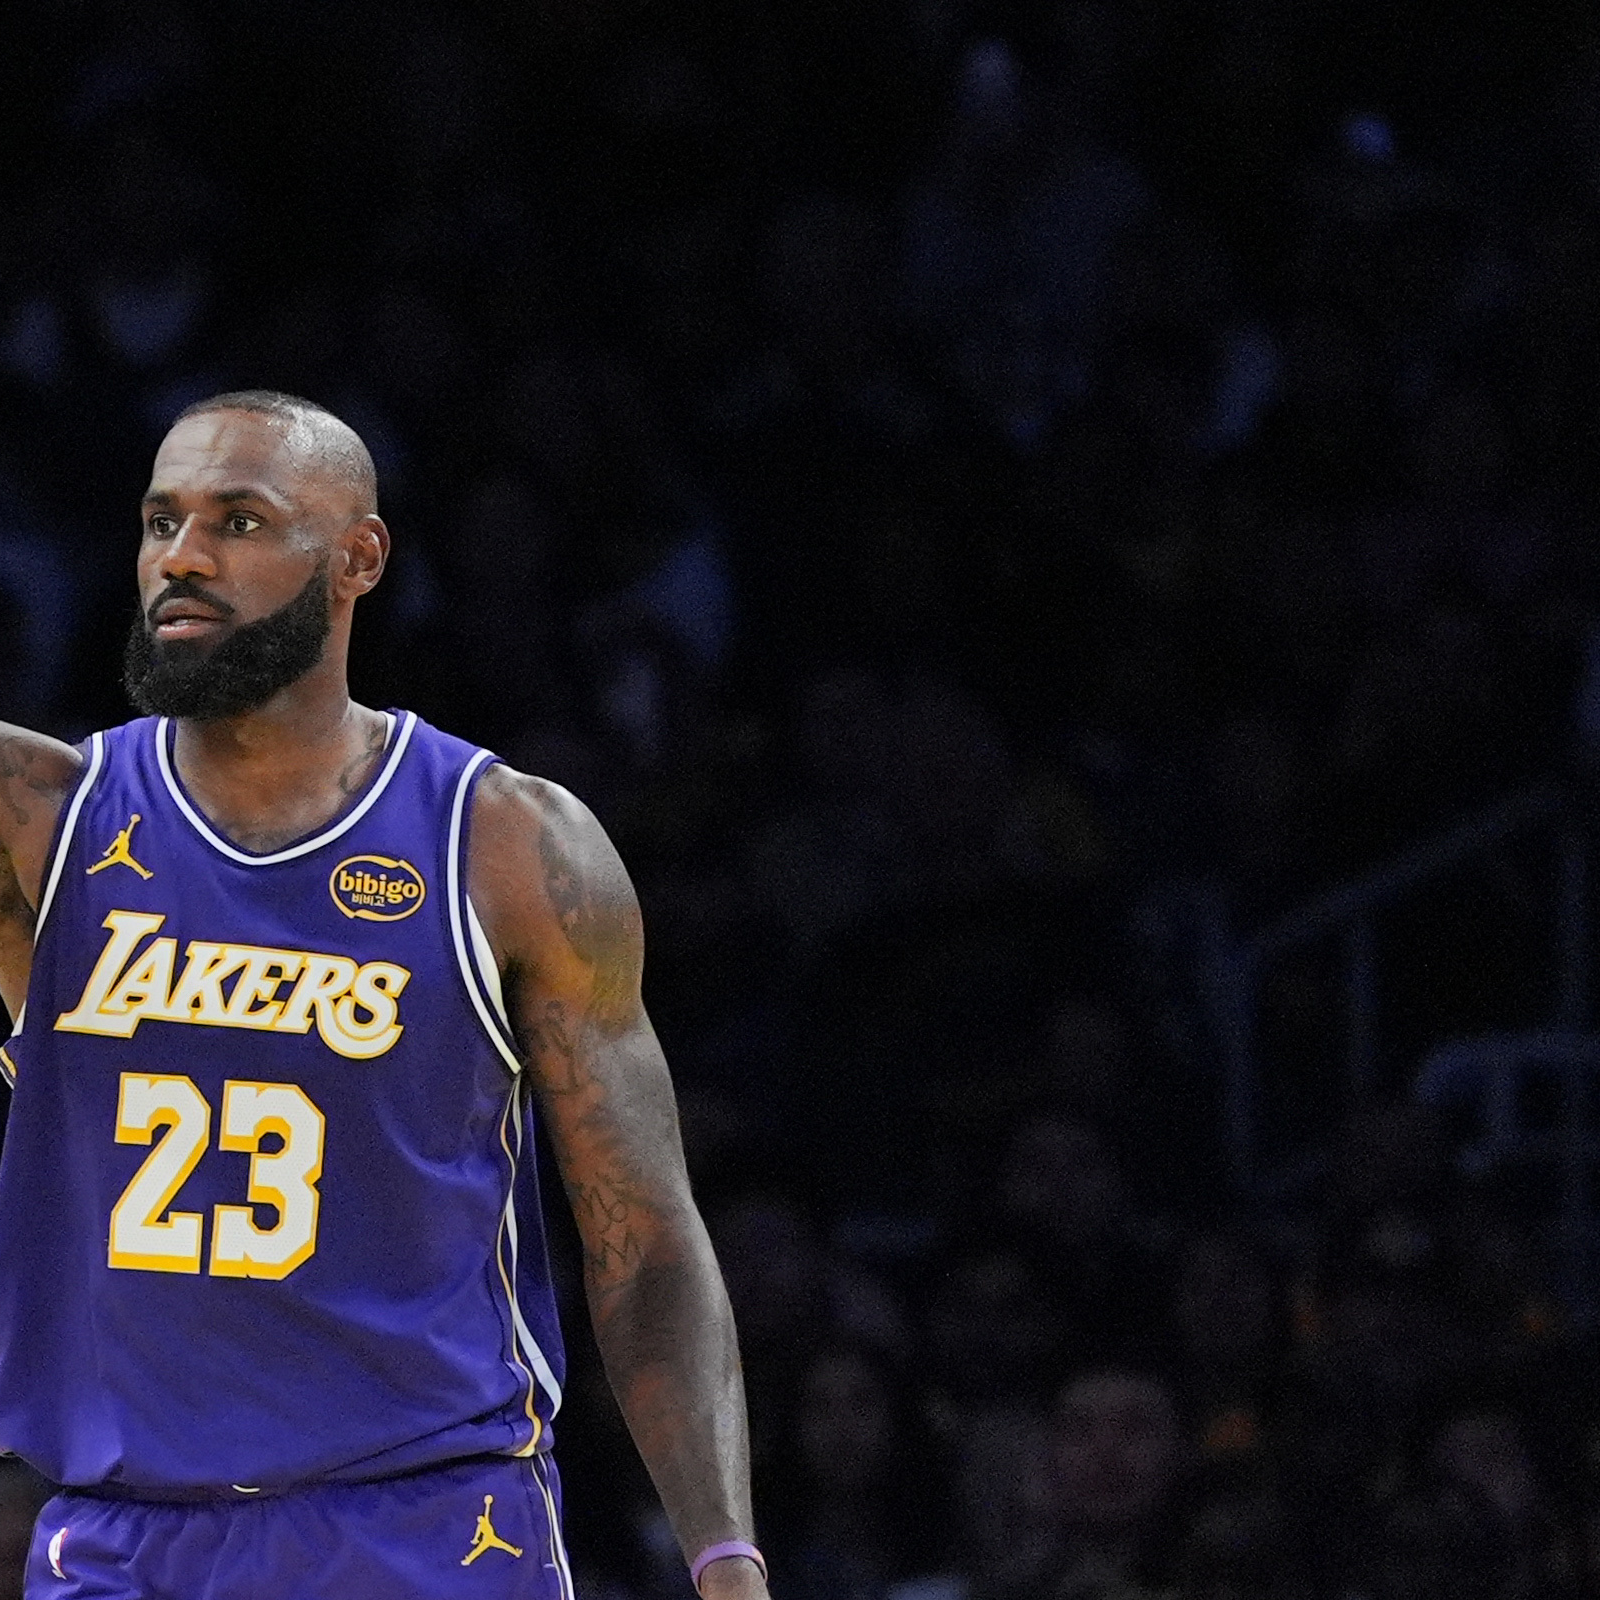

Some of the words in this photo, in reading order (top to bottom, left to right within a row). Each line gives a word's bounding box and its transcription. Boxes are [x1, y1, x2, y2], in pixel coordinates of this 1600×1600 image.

[339, 870, 419, 904] bibigo
[351, 893, 386, 907] 비비고
[53, 910, 411, 1059] LAKERS
[107, 1071, 326, 1281] 23
